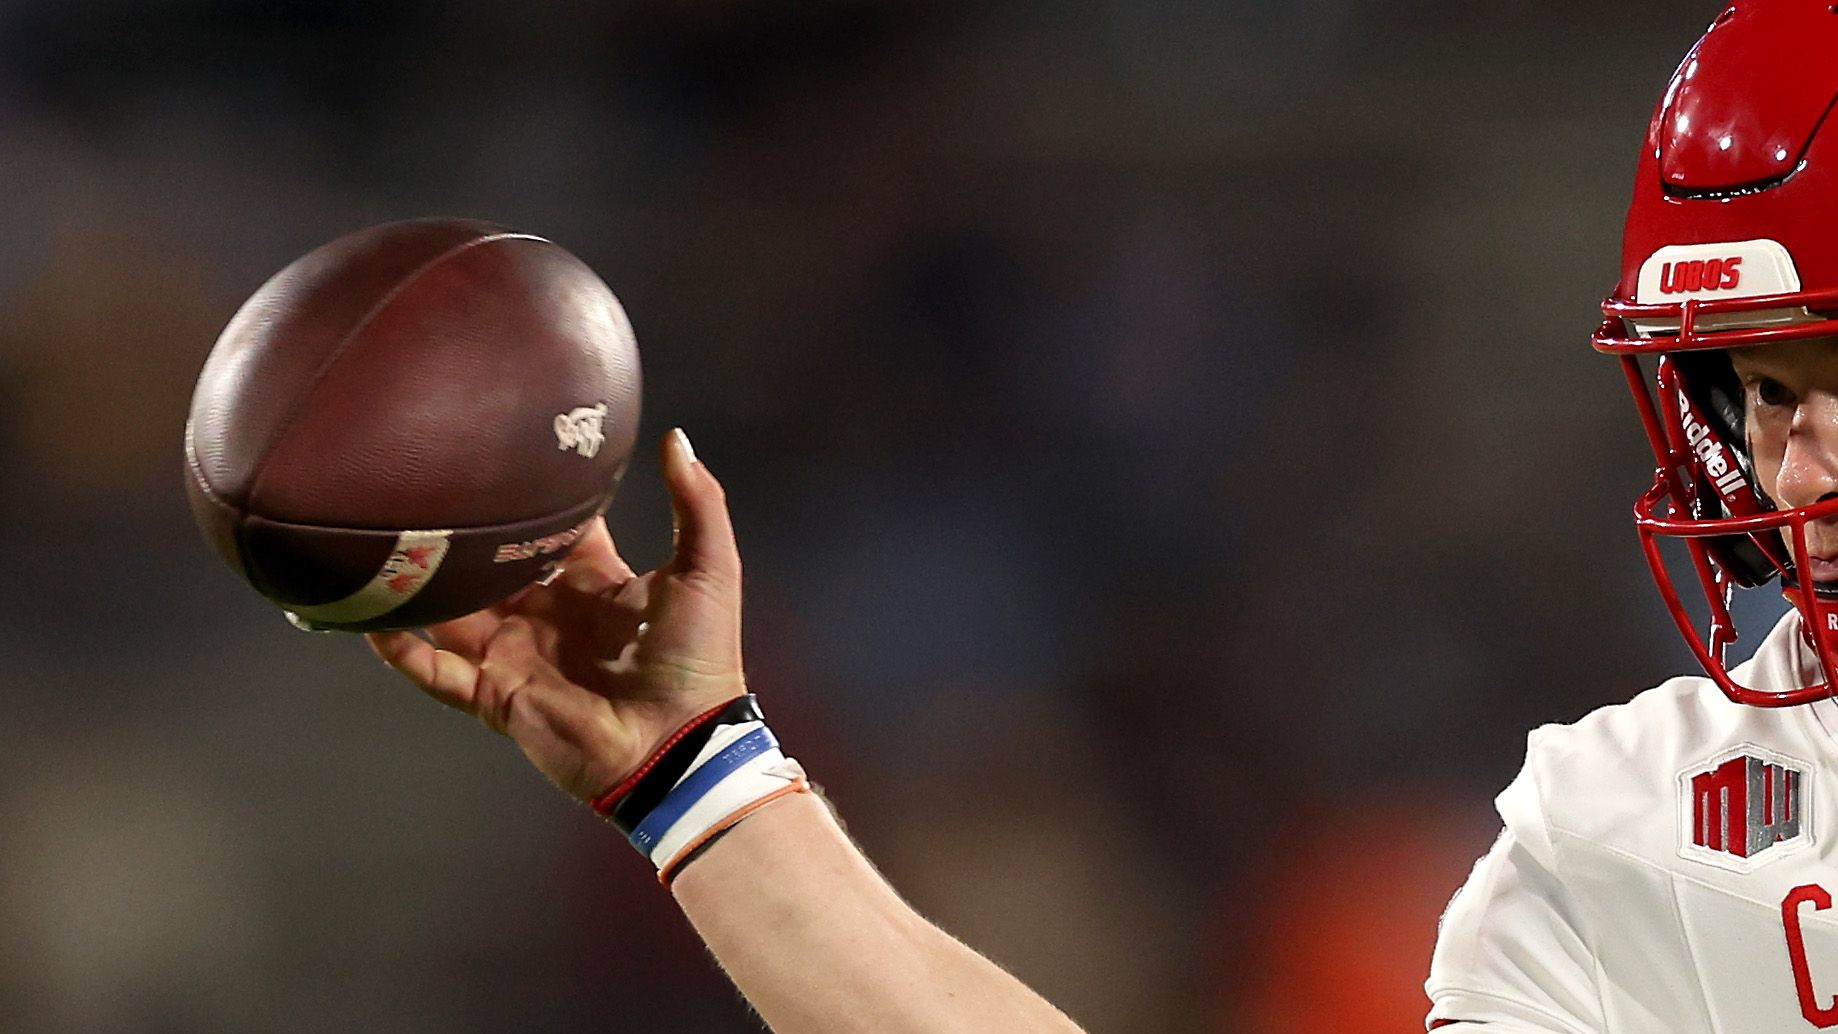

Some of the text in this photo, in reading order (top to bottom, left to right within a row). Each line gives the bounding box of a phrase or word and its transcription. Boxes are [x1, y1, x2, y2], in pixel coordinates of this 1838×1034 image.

[1660, 257, 1743, 294] LOBOS
[1679, 389, 1747, 496] Riddell
[1691, 755, 1800, 859] MW
